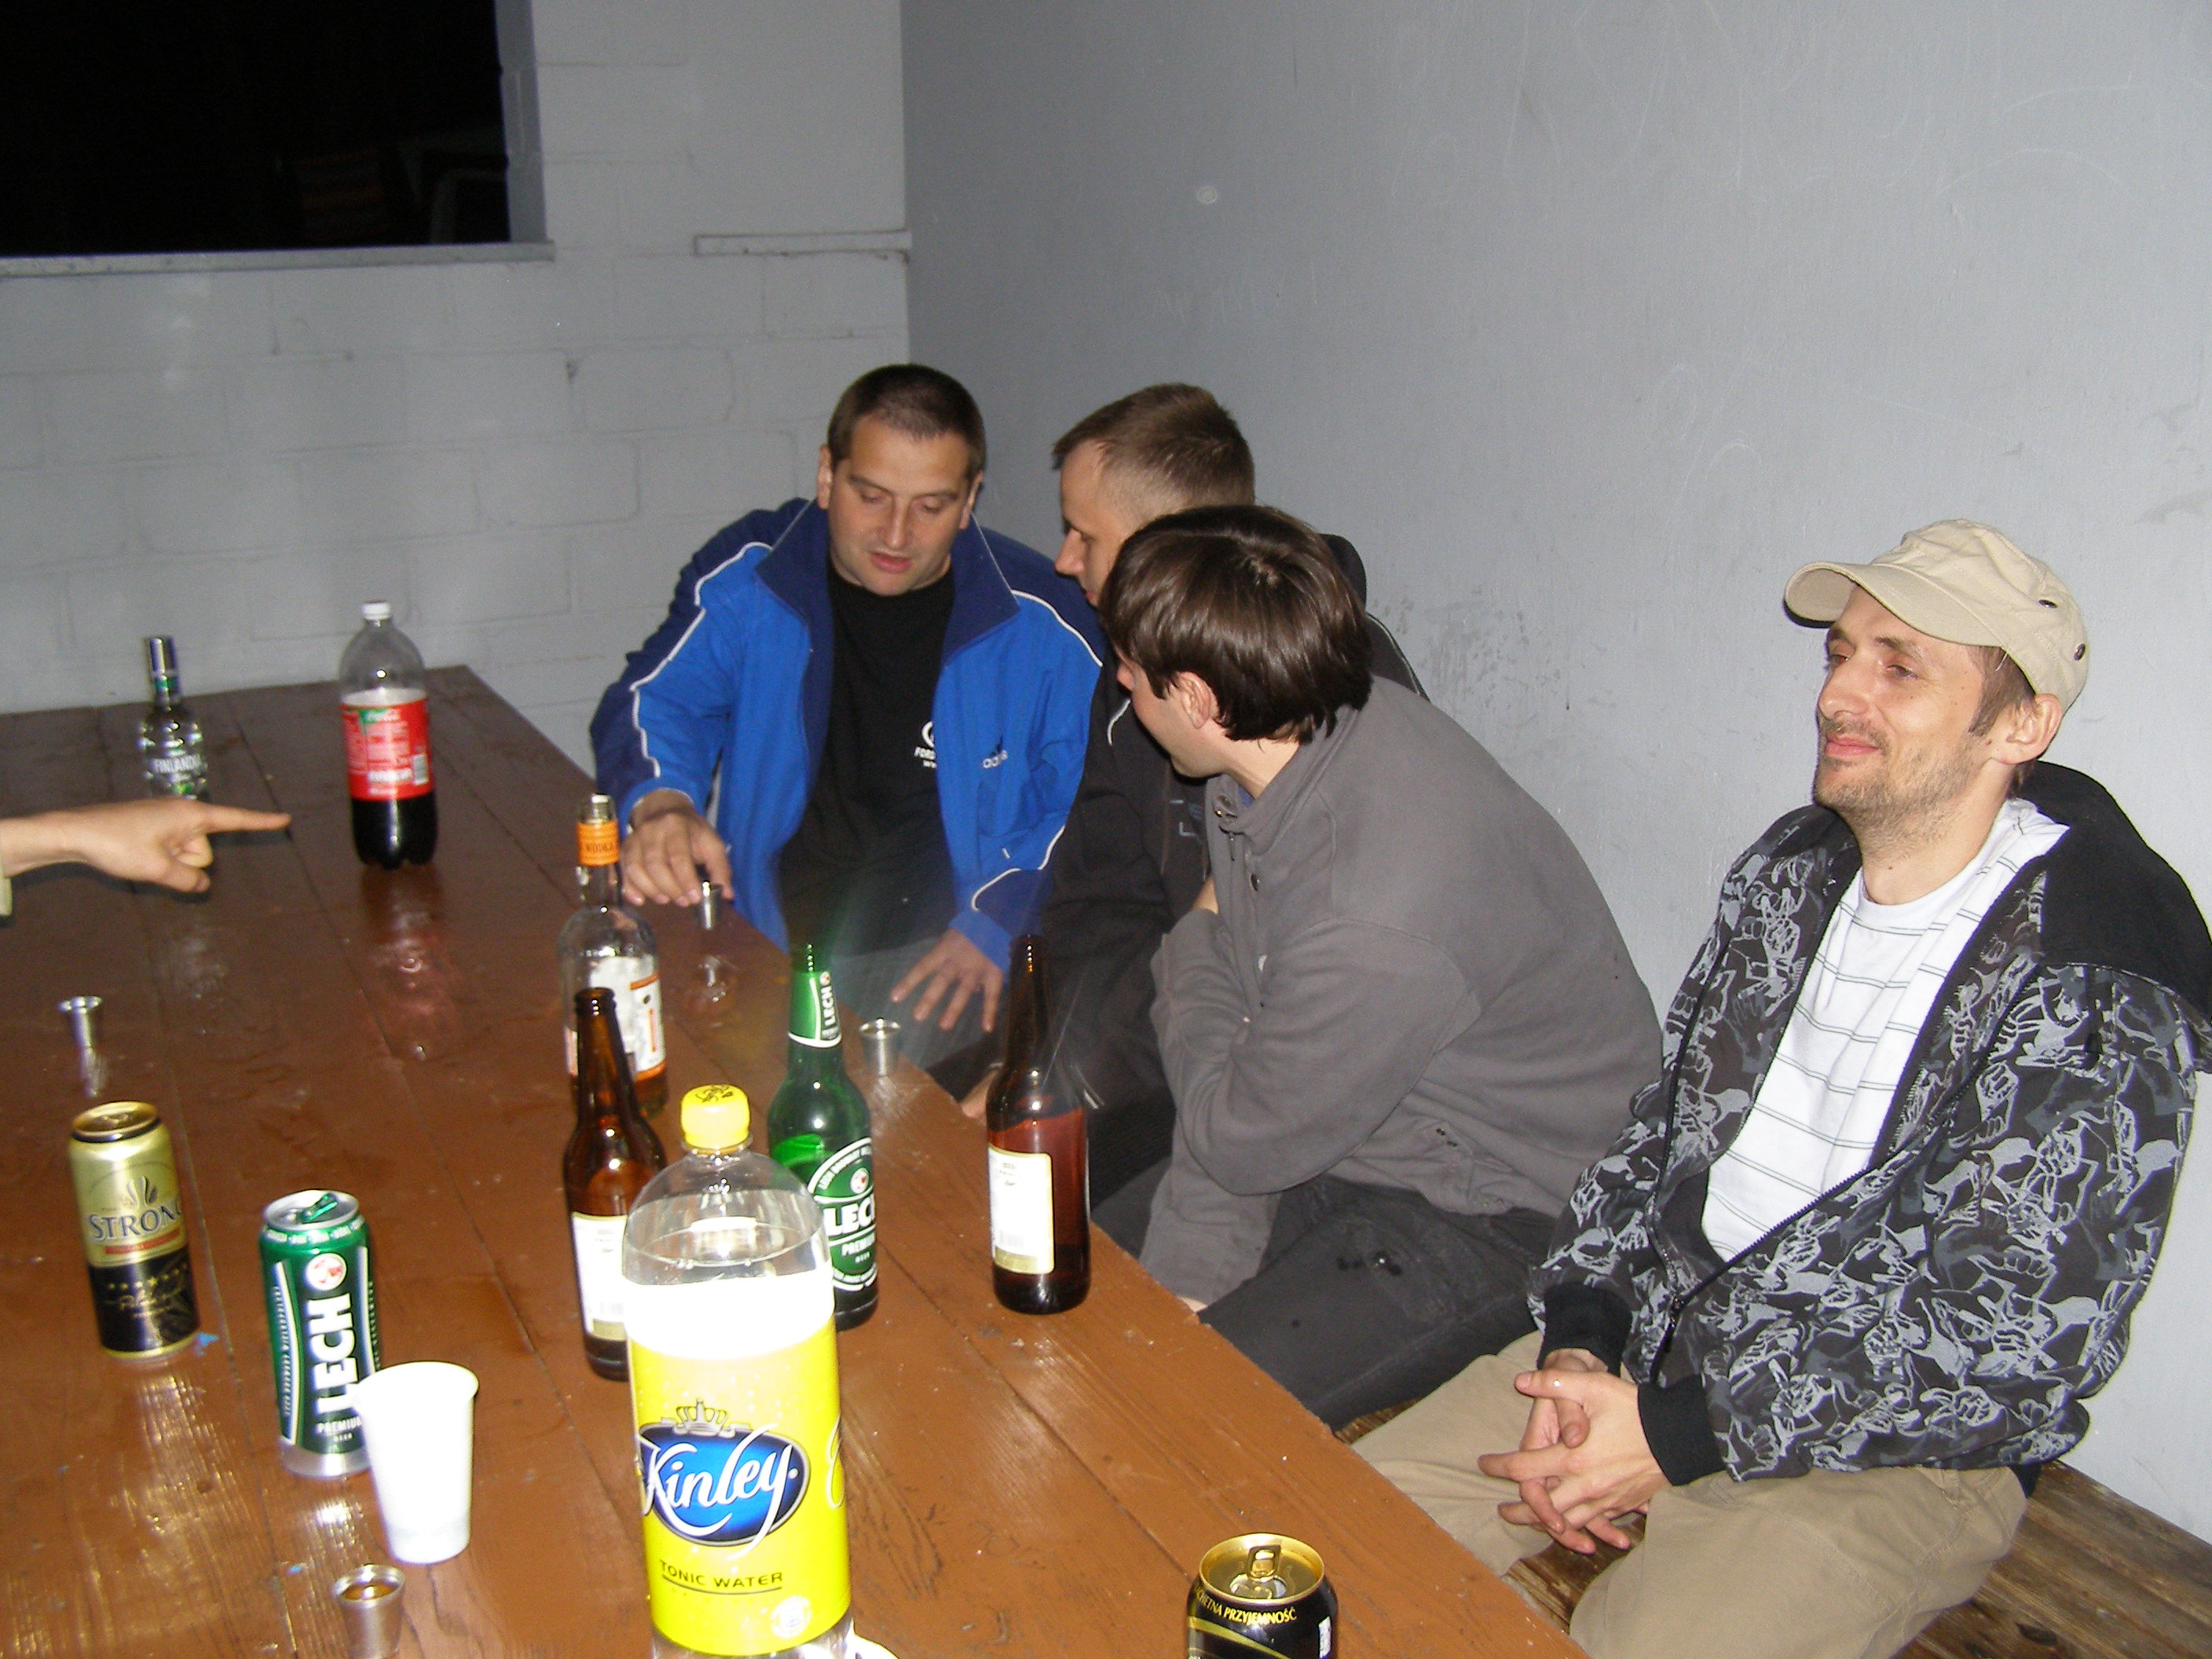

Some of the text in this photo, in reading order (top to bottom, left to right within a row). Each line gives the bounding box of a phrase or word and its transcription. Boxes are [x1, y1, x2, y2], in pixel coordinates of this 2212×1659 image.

[820, 985, 837, 1027] LECH
[309, 1292, 359, 1414] LECH
[639, 1423, 793, 1562] Kinley
[660, 1559, 783, 1588] TONIC WATER
